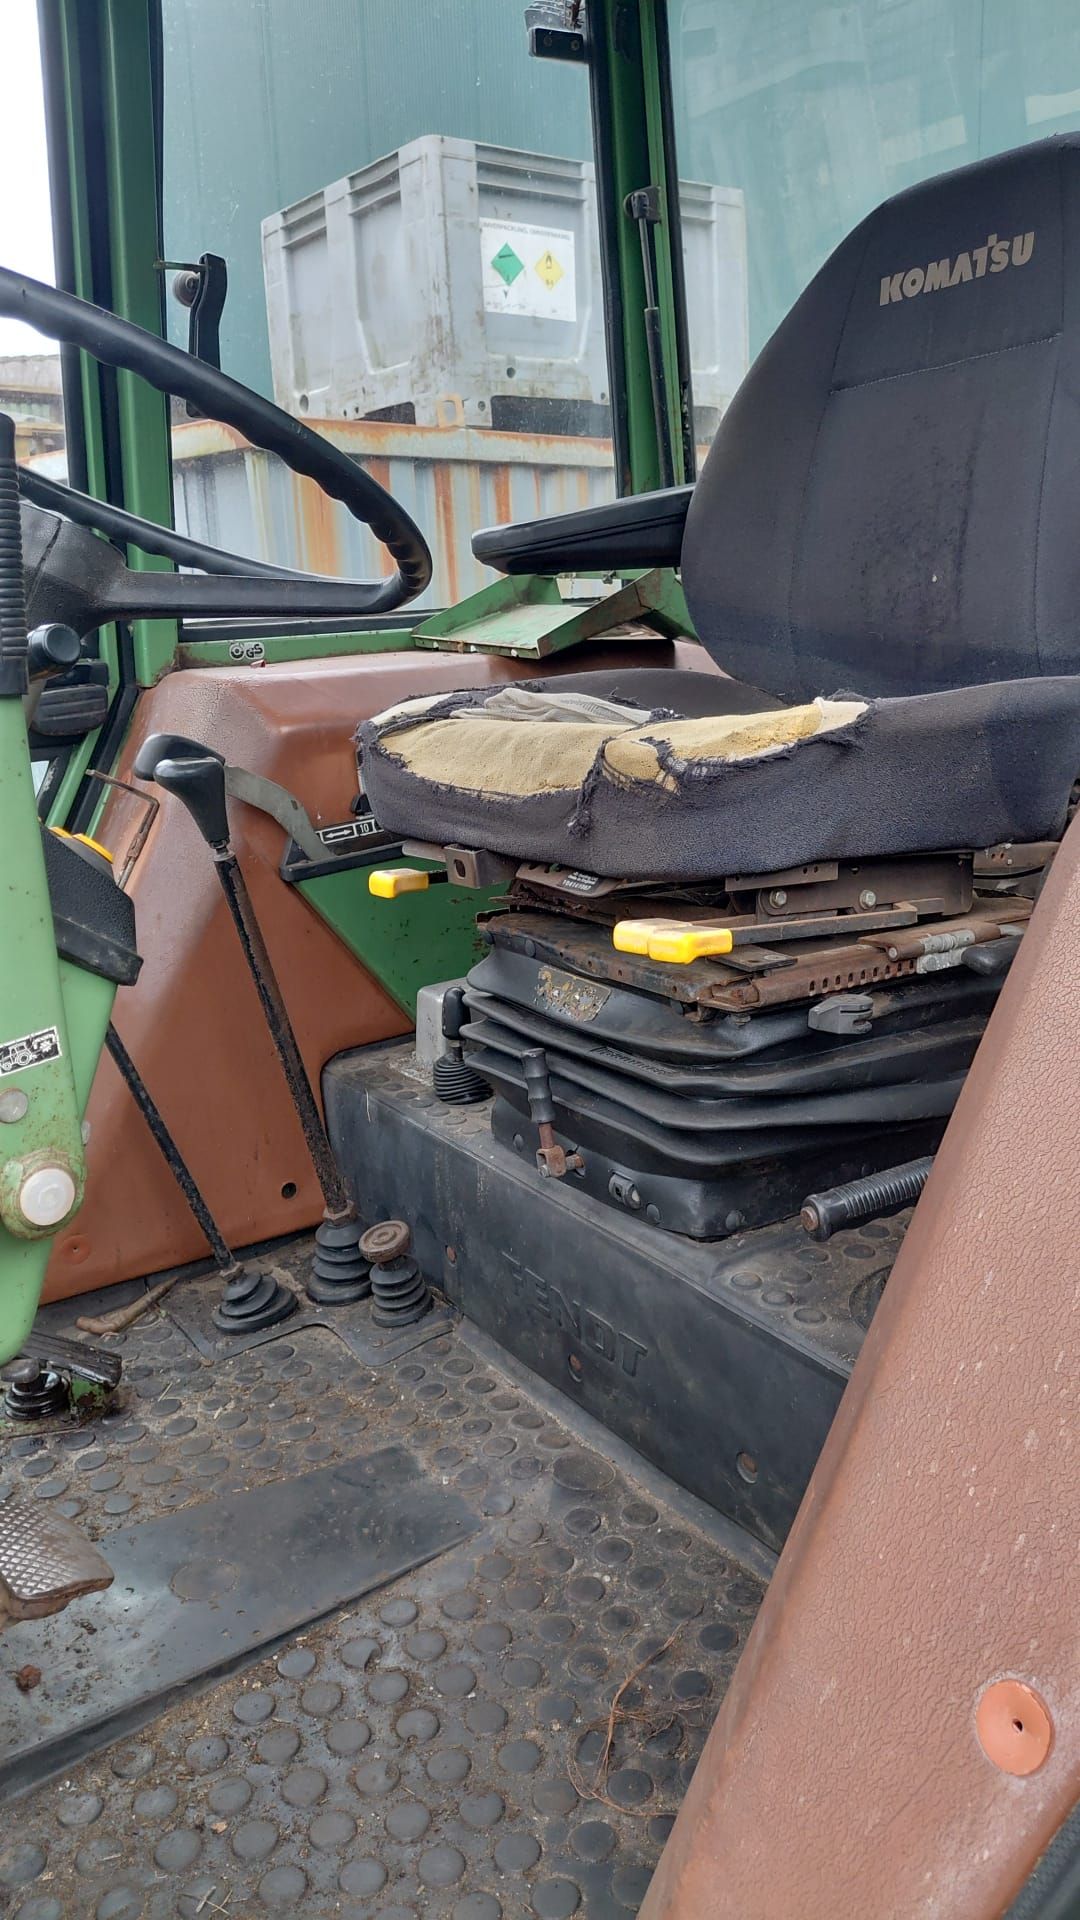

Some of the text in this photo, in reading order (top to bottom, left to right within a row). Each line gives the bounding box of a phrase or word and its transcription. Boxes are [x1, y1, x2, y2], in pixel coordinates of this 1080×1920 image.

[879, 232, 1035, 306] KOMATSU
[246, 644, 263, 658] GS
[360, 823, 370, 833] 10
[501, 1251, 648, 1377] FENDT
